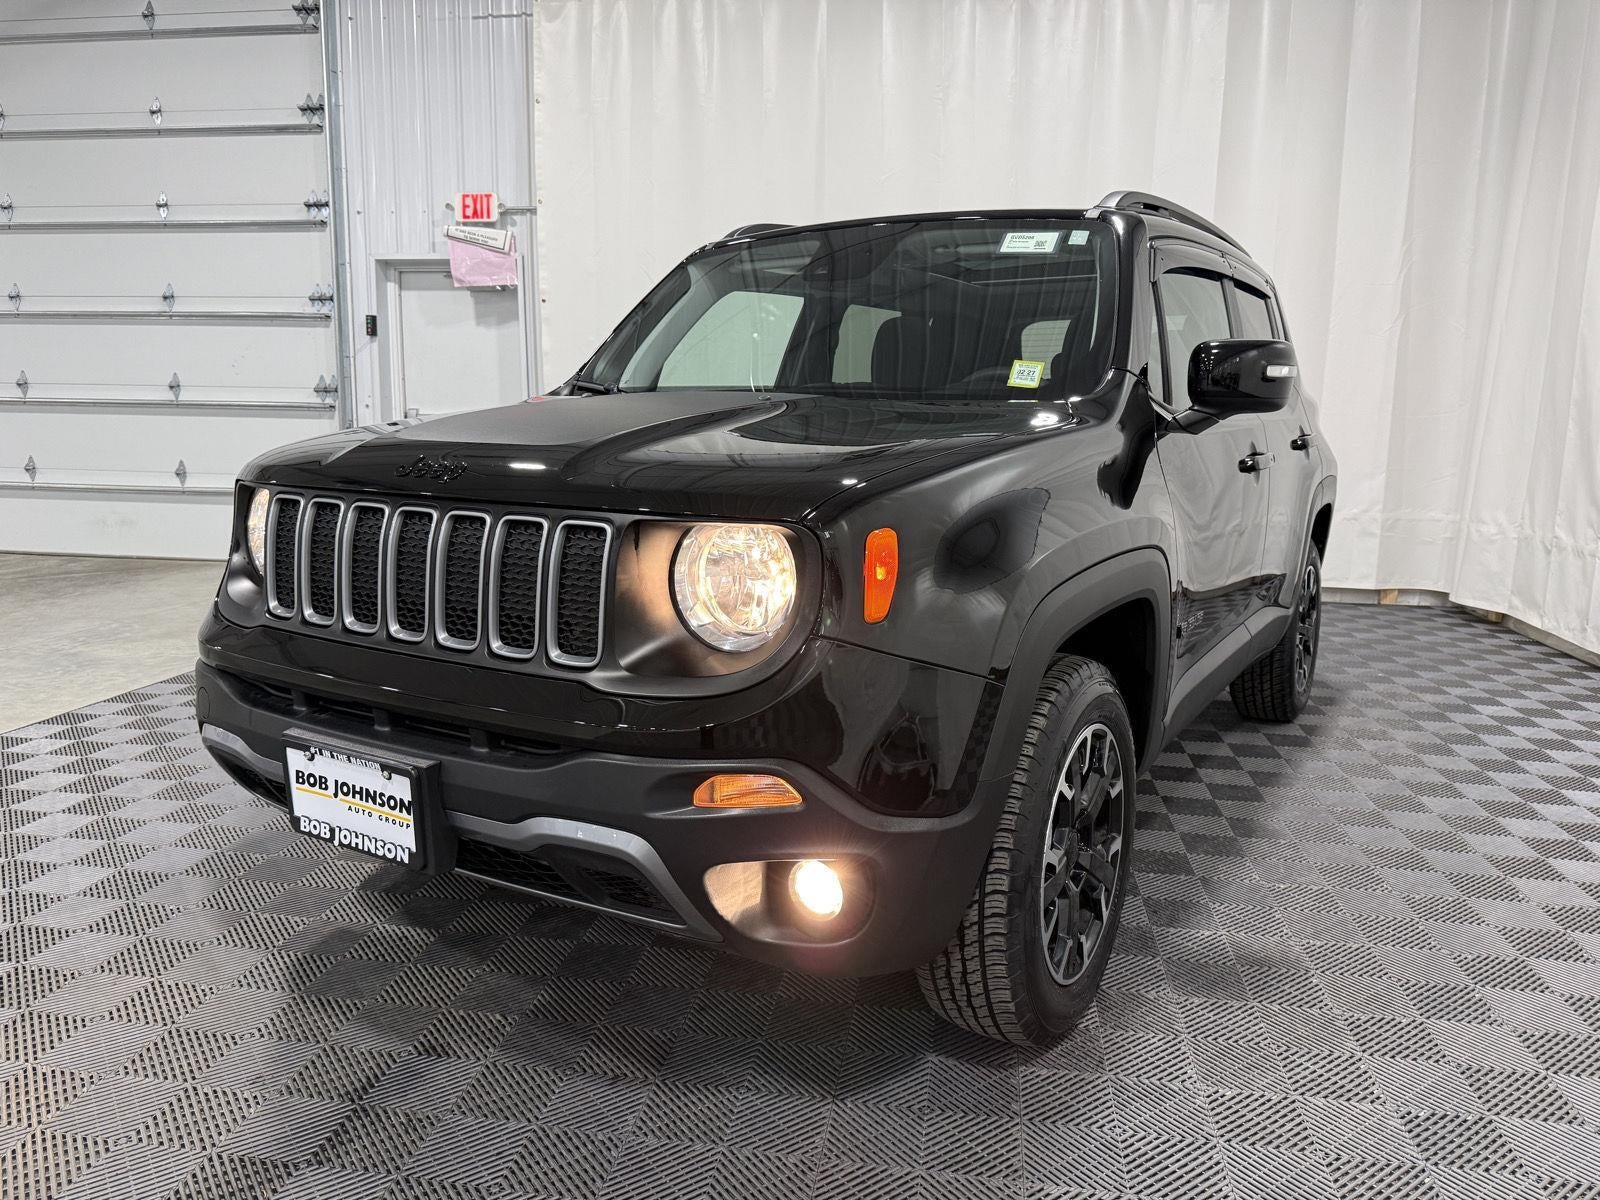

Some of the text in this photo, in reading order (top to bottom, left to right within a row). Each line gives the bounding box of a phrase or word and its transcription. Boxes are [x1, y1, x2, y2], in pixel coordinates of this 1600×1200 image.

[462, 193, 492, 219] EXIT
[396, 455, 468, 485] Jeep
[310, 746, 382, 771] #1 IN THE NATION
[295, 769, 412, 816] BOB JOHNSON
[347, 805, 411, 830] AUTO GROUP
[300, 815, 410, 864] BOB JOHNSON
